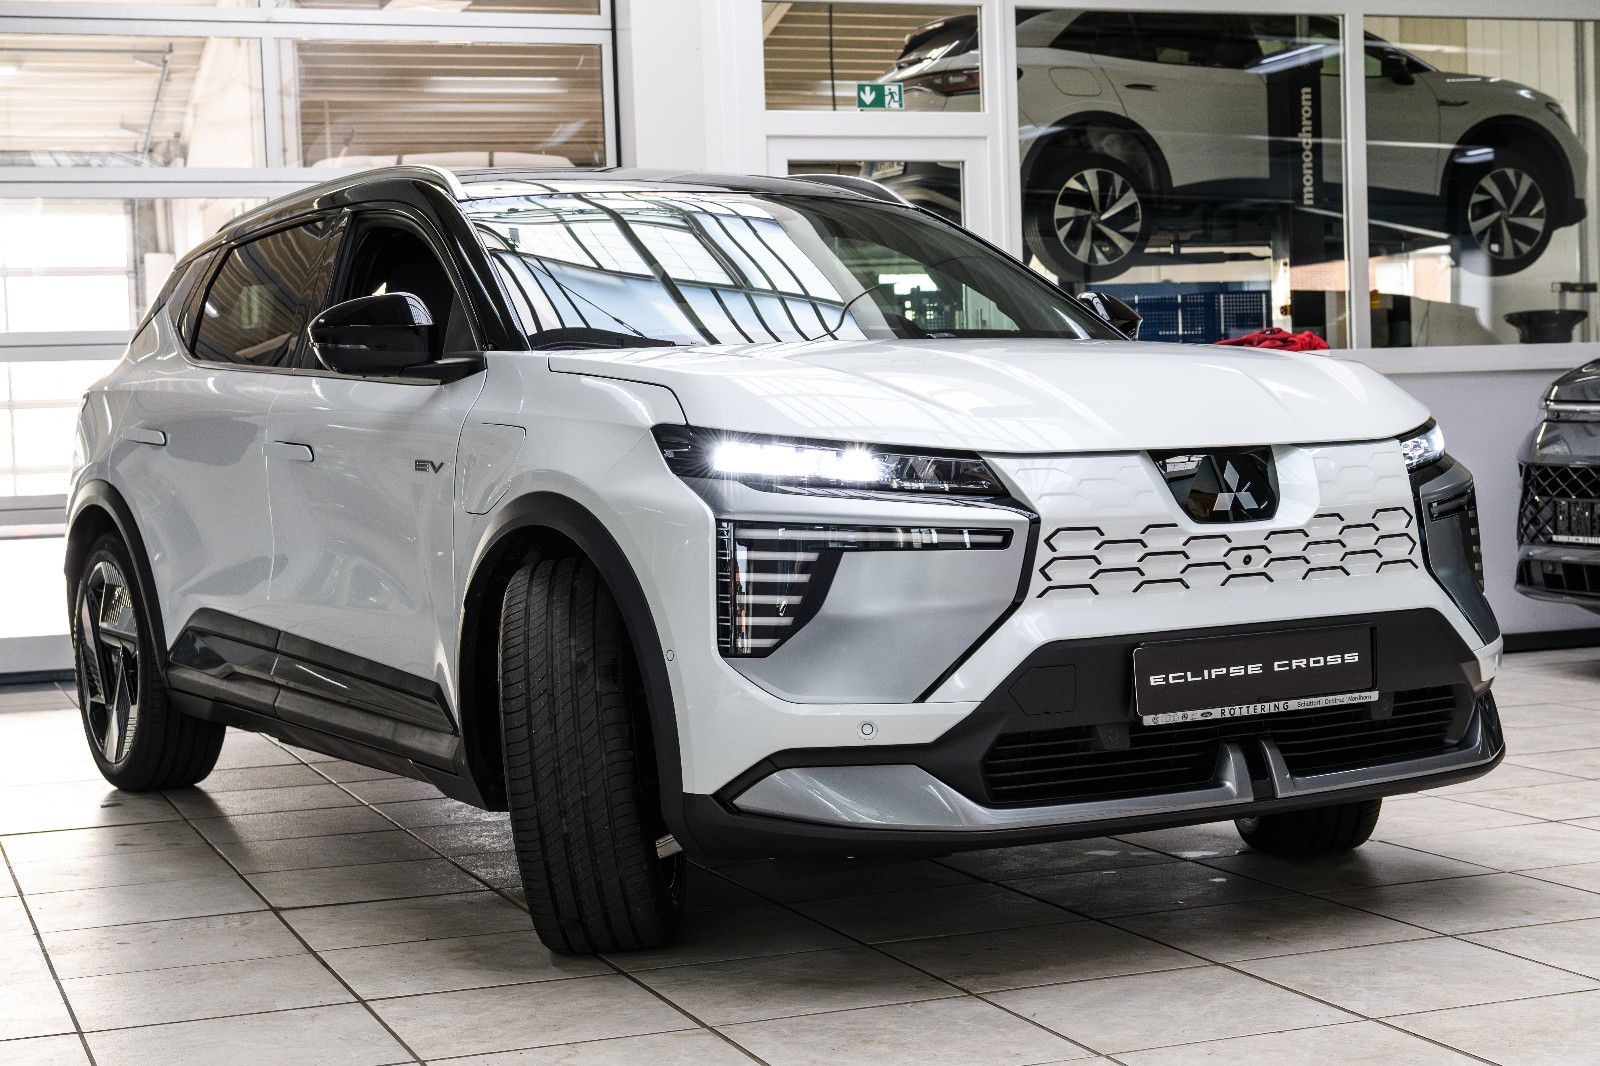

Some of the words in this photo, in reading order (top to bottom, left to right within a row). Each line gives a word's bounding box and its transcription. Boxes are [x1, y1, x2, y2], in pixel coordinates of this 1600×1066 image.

[1298, 86, 1314, 205] monochrom
[415, 459, 445, 474] EV
[1150, 663, 1263, 686] ECLIPSE
[1273, 652, 1359, 672] CROSS
